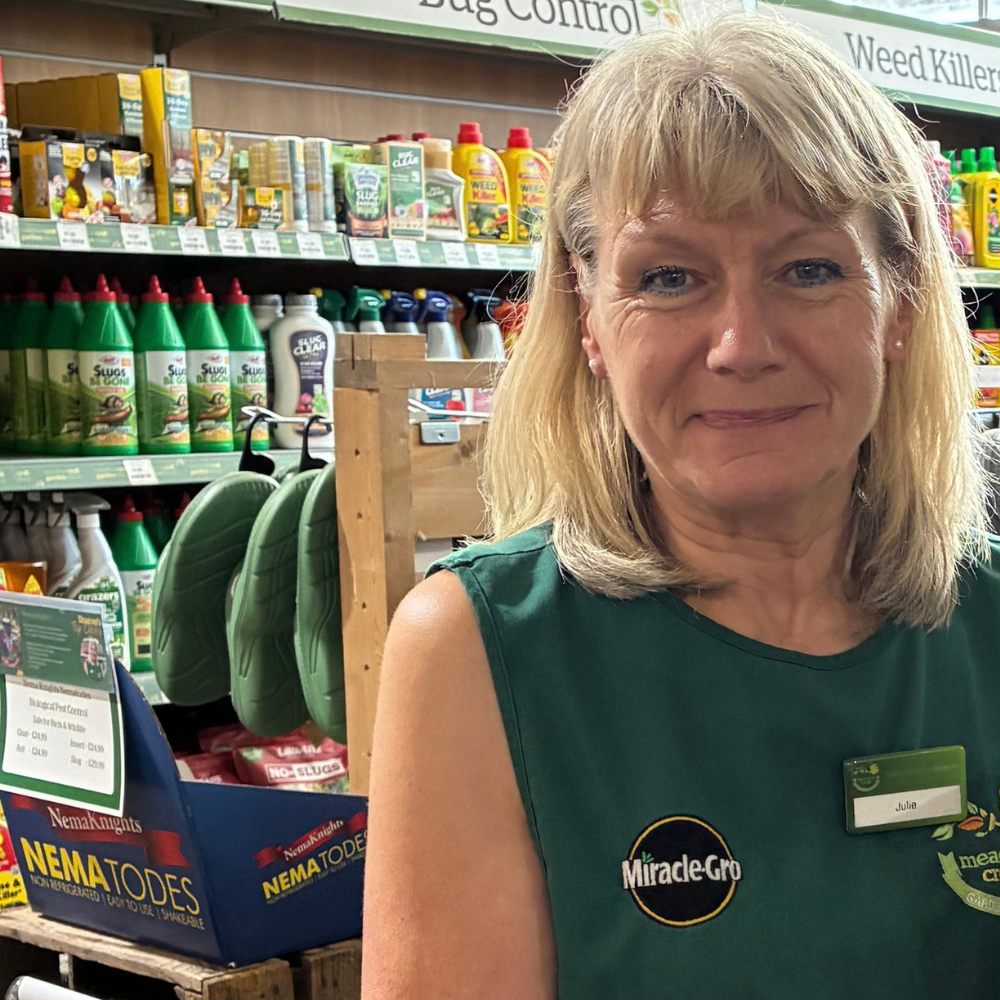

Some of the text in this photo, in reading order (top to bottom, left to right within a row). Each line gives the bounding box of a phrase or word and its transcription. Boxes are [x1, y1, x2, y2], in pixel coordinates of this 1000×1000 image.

[845, 32, 927, 81] Weed
[47, 806, 143, 836] NemaKnights
[894, 799, 917, 813] Julie
[284, 819, 344, 861] NemaKnights
[20, 837, 200, 916] NEMATODES
[622, 853, 742, 890] Miracle-Gro
